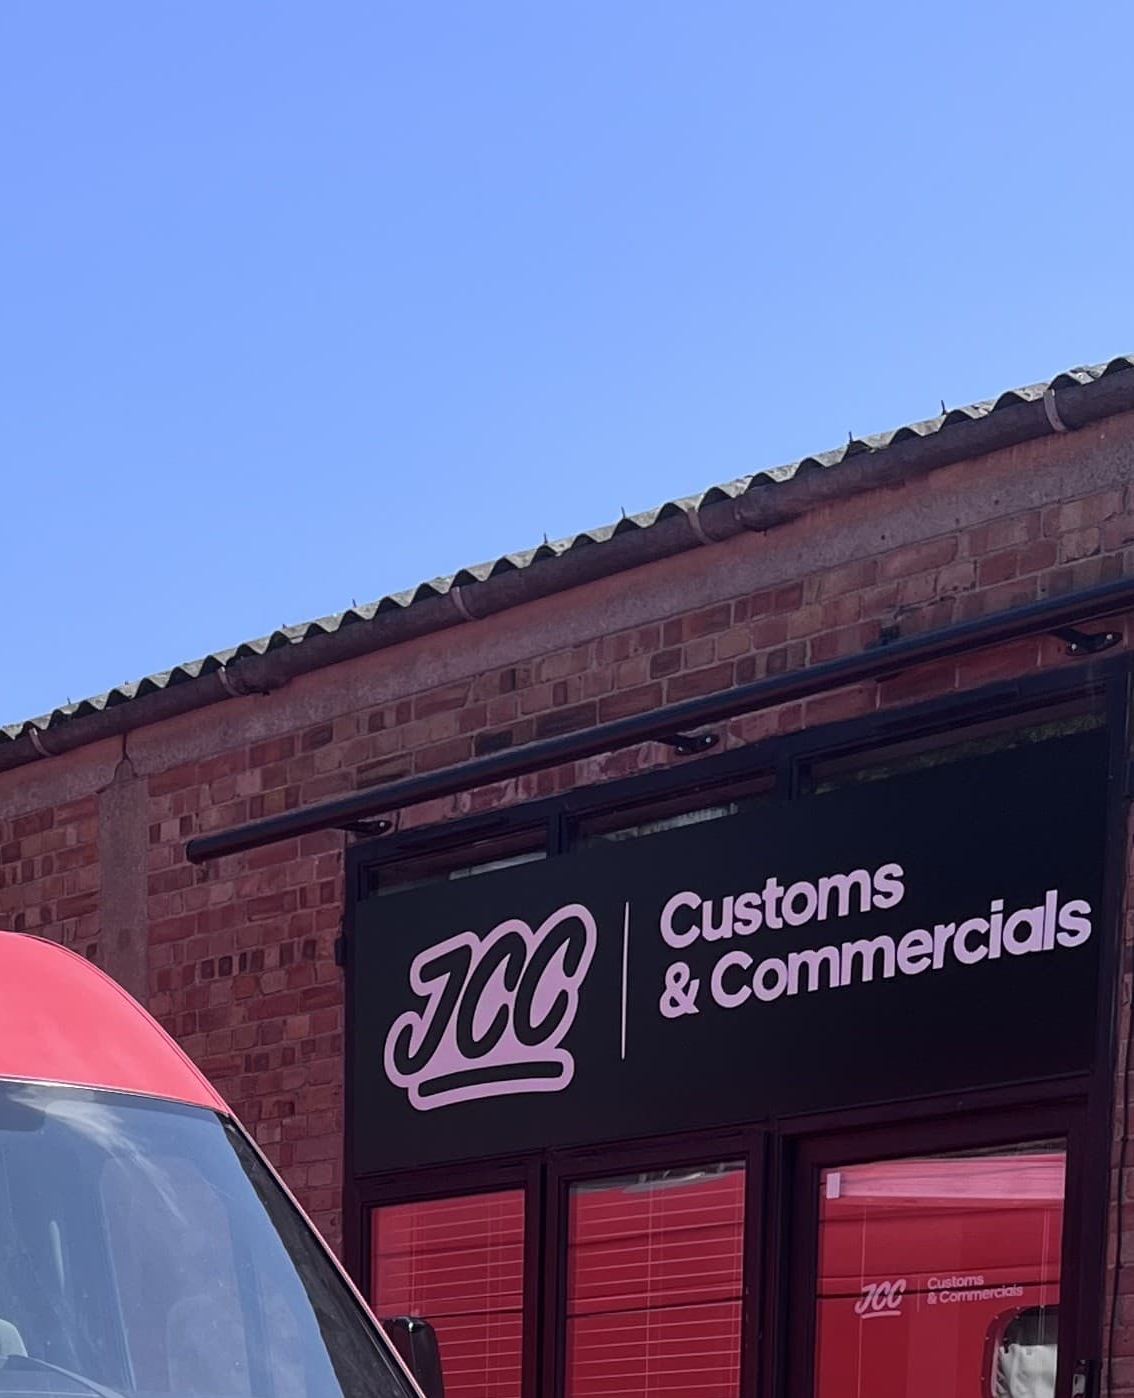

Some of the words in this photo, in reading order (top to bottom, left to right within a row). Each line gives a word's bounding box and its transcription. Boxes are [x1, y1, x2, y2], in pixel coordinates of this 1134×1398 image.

[660, 863, 905, 949] Customs
[659, 962, 700, 1018] &
[710, 889, 1092, 1009] Commercials
[385, 904, 597, 1087] JCC
[854, 1278, 907, 1314] JCC
[927, 1274, 985, 1290] Customs
[927, 1292, 938, 1305] &
[939, 1284, 1024, 1304] Commercials
